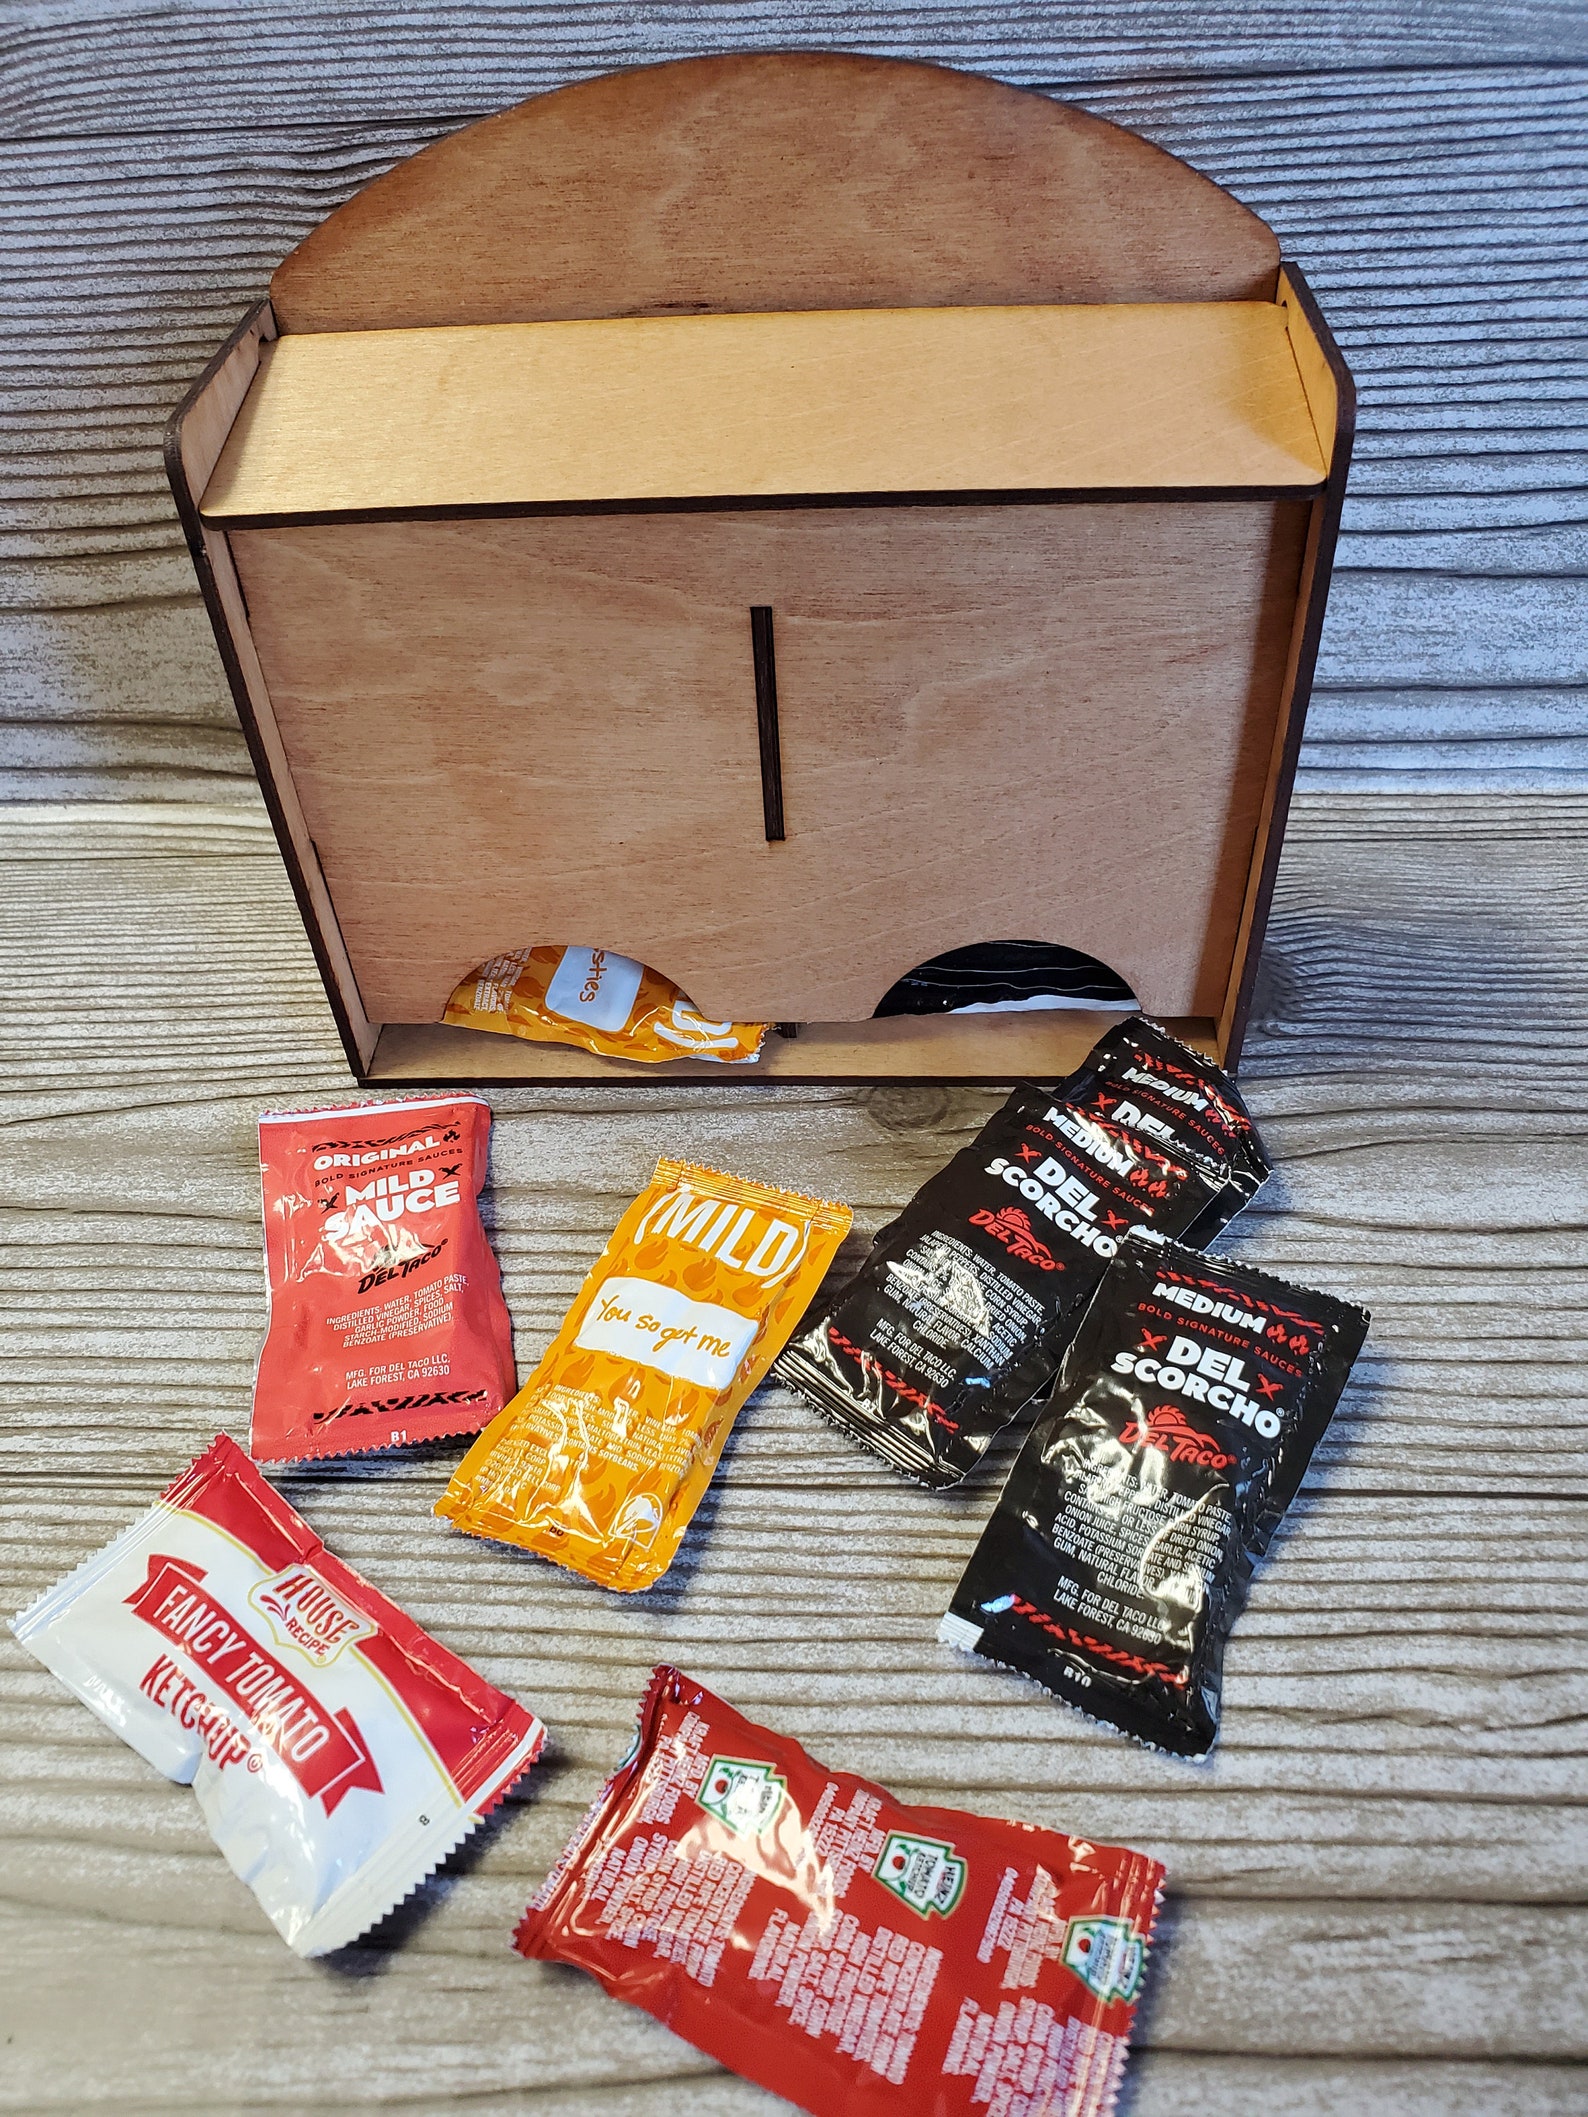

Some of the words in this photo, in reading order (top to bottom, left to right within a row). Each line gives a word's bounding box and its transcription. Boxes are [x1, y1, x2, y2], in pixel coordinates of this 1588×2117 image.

[579, 947, 607, 1002] sties
[1122, 1067, 1206, 1111] MEDIUM
[1105, 1080, 1130, 1092] BOLD
[1132, 1089, 1187, 1120] SIGNATURE
[1188, 1118, 1225, 1155] SAUCES
[1111, 1100, 1174, 1139] DEL
[313, 1136, 440, 1170] ORIGINAL
[1043, 1107, 1135, 1177] MEDIUM
[315, 1174, 343, 1188] BOLD
[349, 1160, 413, 1179] SIGNATURE
[418, 1149, 463, 1162] SAUCES
[346, 1169, 435, 1205] MILD
[1026, 1124, 1054, 1142] BOLD
[1056, 1140, 1109, 1188] SIGNATURE
[1112, 1187, 1155, 1216] SAUCES
[1033, 1157, 1101, 1222] DEL
[323, 1181, 460, 1241] SAUCE
[984, 1158, 1117, 1258] SCORCHO
[906, 1249, 937, 1273] CONTAINS
[968, 1209, 1008, 1244] DEL
[1006, 1234, 1056, 1271] TACO
[358, 1268, 399, 1294] DEL
[931, 1230, 973, 1259] INGREDIENTS:
[972, 1254, 996, 1277] WATER,
[996, 1272, 1024, 1296] TOMATO
[1023, 1293, 1045, 1316] PASTE,
[949, 1249, 980, 1277] PEPPERS,
[979, 1272, 1013, 1303] DISTILLED
[327, 1306, 382, 1325] INGREDIENTS:
[384, 1295, 412, 1309] WATER,
[414, 1280, 442, 1298] TOMATO
[444, 1274, 469, 1286] PASTE,
[334, 1315, 373, 1331] DISTILLED
[376, 1304, 411, 1320] VINEGAR,
[414, 1290, 443, 1307] SPICES,
[444, 1283, 463, 1294] SALT,
[355, 1320, 384, 1333] GARLIC
[387, 1307, 421, 1325] POWDER,
[424, 1298, 443, 1310] FOOD
[423, 1302, 453, 1320] SODIUM
[886, 1273, 921, 1300] BENZOATE
[972, 1333, 1006, 1366] XANTHAN
[985, 1289, 1006, 1309] CORN
[1152, 1282, 1267, 1334] MEDIUM
[343, 1334, 385, 1348] BENZOATE
[597, 1295, 631, 1322] You
[635, 1314, 661, 1332] so
[652, 1327, 698, 1352] got
[697, 1334, 731, 1358] me
[884, 1285, 903, 1304] GUM,
[902, 1298, 934, 1326] NATURAL
[933, 1320, 962, 1344] FLAVOR,
[961, 1338, 994, 1370] CALCIUM
[913, 1320, 950, 1349] CHLORIDE.
[985, 1301, 1006, 1322] DRIED
[1005, 1319, 1028, 1344] ONION,
[988, 1331, 1013, 1360] SODIUM
[992, 1323, 1017, 1347] ACETIC
[1138, 1302, 1172, 1320] BOLD
[1177, 1317, 1250, 1348] SIGNATURE
[1254, 1346, 1303, 1377] SAUCES
[346, 1369, 366, 1380] MFG.
[369, 1366, 386, 1376] FOR
[389, 1363, 405, 1372] DEL
[408, 1358, 429, 1369] TACO
[432, 1354, 450, 1364] LLC.
[870, 1329, 890, 1347] LAKE
[887, 1342, 916, 1368] FOREST,
[915, 1360, 926, 1373] CA
[925, 1368, 949, 1388] 92630
[876, 1318, 894, 1336] MFG.
[895, 1332, 911, 1346] FOR
[909, 1342, 924, 1356] DEL
[923, 1351, 941, 1367] TACO
[940, 1363, 957, 1380] LLC.
[1166, 1336, 1250, 1392] DEL
[347, 1378, 368, 1390] LAKE
[370, 1372, 405, 1387] FOREST,
[408, 1370, 419, 1379] CA
[422, 1365, 449, 1378] 92630
[1110, 1352, 1281, 1439] SCORCHO
[1119, 1421, 1170, 1451] DEL
[1170, 1435, 1227, 1469] TACO
[1122, 1514, 1134, 1524] OR
[1135, 1519, 1158, 1535] LESS
[1206, 1503, 1232, 1524] PASTE,
[1052, 1523, 1094, 1551] BENZOATE
[1054, 1536, 1075, 1559] GUM,
[1078, 1549, 1118, 1578] NATURAL
[1055, 1513, 1076, 1531] ACID,
[1081, 1524, 1125, 1552] POTASSIUM
[1127, 1542, 1163, 1566] SORATE
[1165, 1557, 1182, 1570] AND
[1065, 1505, 1093, 1521] ONION
[1092, 1516, 1117, 1535] JUICE,
[1185, 1550, 1216, 1569] ACETIC
[1170, 1531, 1198, 1547] DRIED
[1197, 1540, 1224, 1562] ONION,
[273, 1574, 360, 1644] HOUSE
[1058, 1575, 1079, 1596] MFG.
[1082, 1589, 1100, 1606] FOR
[1102, 1600, 1119, 1614] DEL
[1122, 1605, 1146, 1624] TACO
[1097, 1572, 1144, 1600] CHLORIDE.
[1054, 1589, 1075, 1609] LAKE
[1077, 1604, 1114, 1628] FOREST,
[1116, 1619, 1131, 1633] CA
[286, 1617, 331, 1655] RECIPE
[153, 1584, 247, 1664] FANCY
[225, 1651, 330, 1763] TOMATO
[139, 1653, 251, 1771] KETCHUP
[656, 1785, 681, 1824] FOODS
[915, 1854, 938, 1899] TOMATO
[935, 1866, 956, 1904] HEINZ
